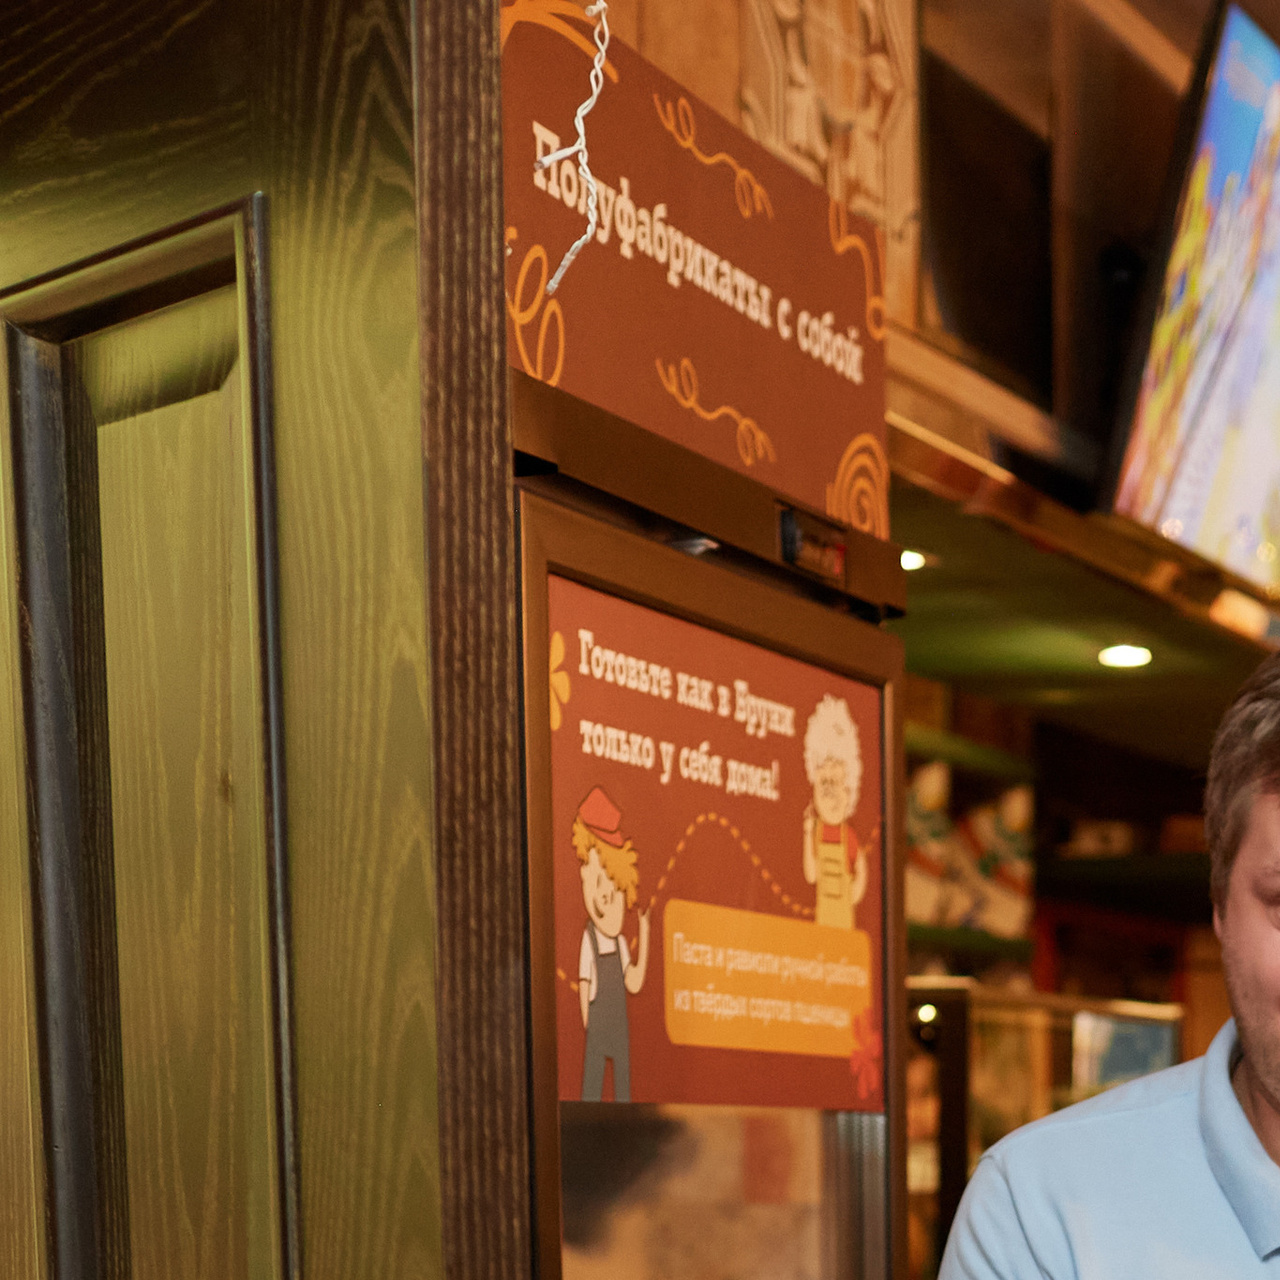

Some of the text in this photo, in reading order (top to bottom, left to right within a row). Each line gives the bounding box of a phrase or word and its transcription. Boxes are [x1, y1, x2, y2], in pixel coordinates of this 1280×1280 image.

[777, 298, 793, 341] с
[797, 311, 864, 385] собой
[577, 628, 673, 700] Готовьте
[676, 671, 714, 713] как
[717, 684, 731, 718] в
[579, 719, 780, 801] только у себя дома!
